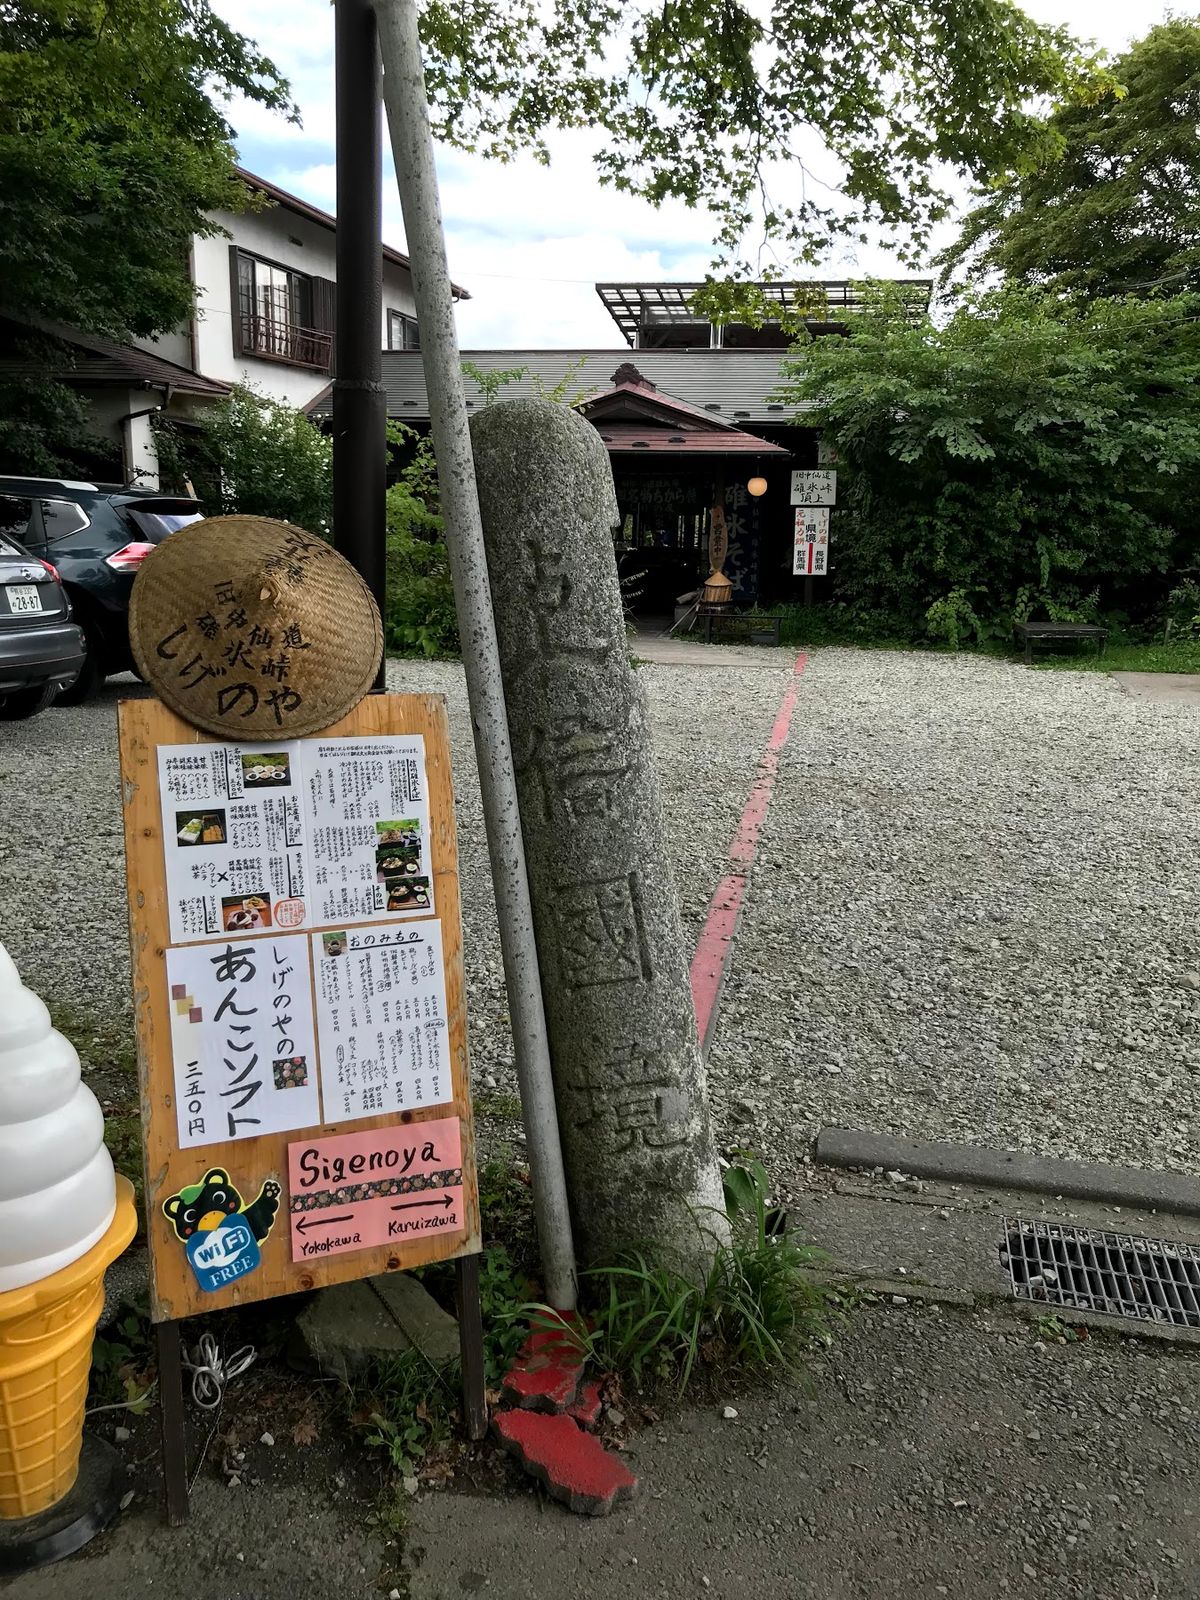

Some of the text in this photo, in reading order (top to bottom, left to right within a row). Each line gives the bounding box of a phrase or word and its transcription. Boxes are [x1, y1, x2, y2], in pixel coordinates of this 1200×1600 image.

[800, 492, 824, 504] 頂上
[806, 524, 816, 542] 県境
[796, 550, 806, 570] 群馬県
[814, 550, 824, 571] 長野県
[156, 623, 302, 726] しげのや
[350, 931, 419, 948] おのみもの
[271, 946, 294, 1054] しげのやの
[210, 944, 262, 1137] あんこソフト
[184, 1061, 206, 1136] 三五〇円
[300, 1142, 442, 1188] Sigenoya
[388, 1214, 458, 1236] Karuizawa
[300, 1233, 362, 1256] Yokokawa
[208, 1256, 254, 1287] FREE
